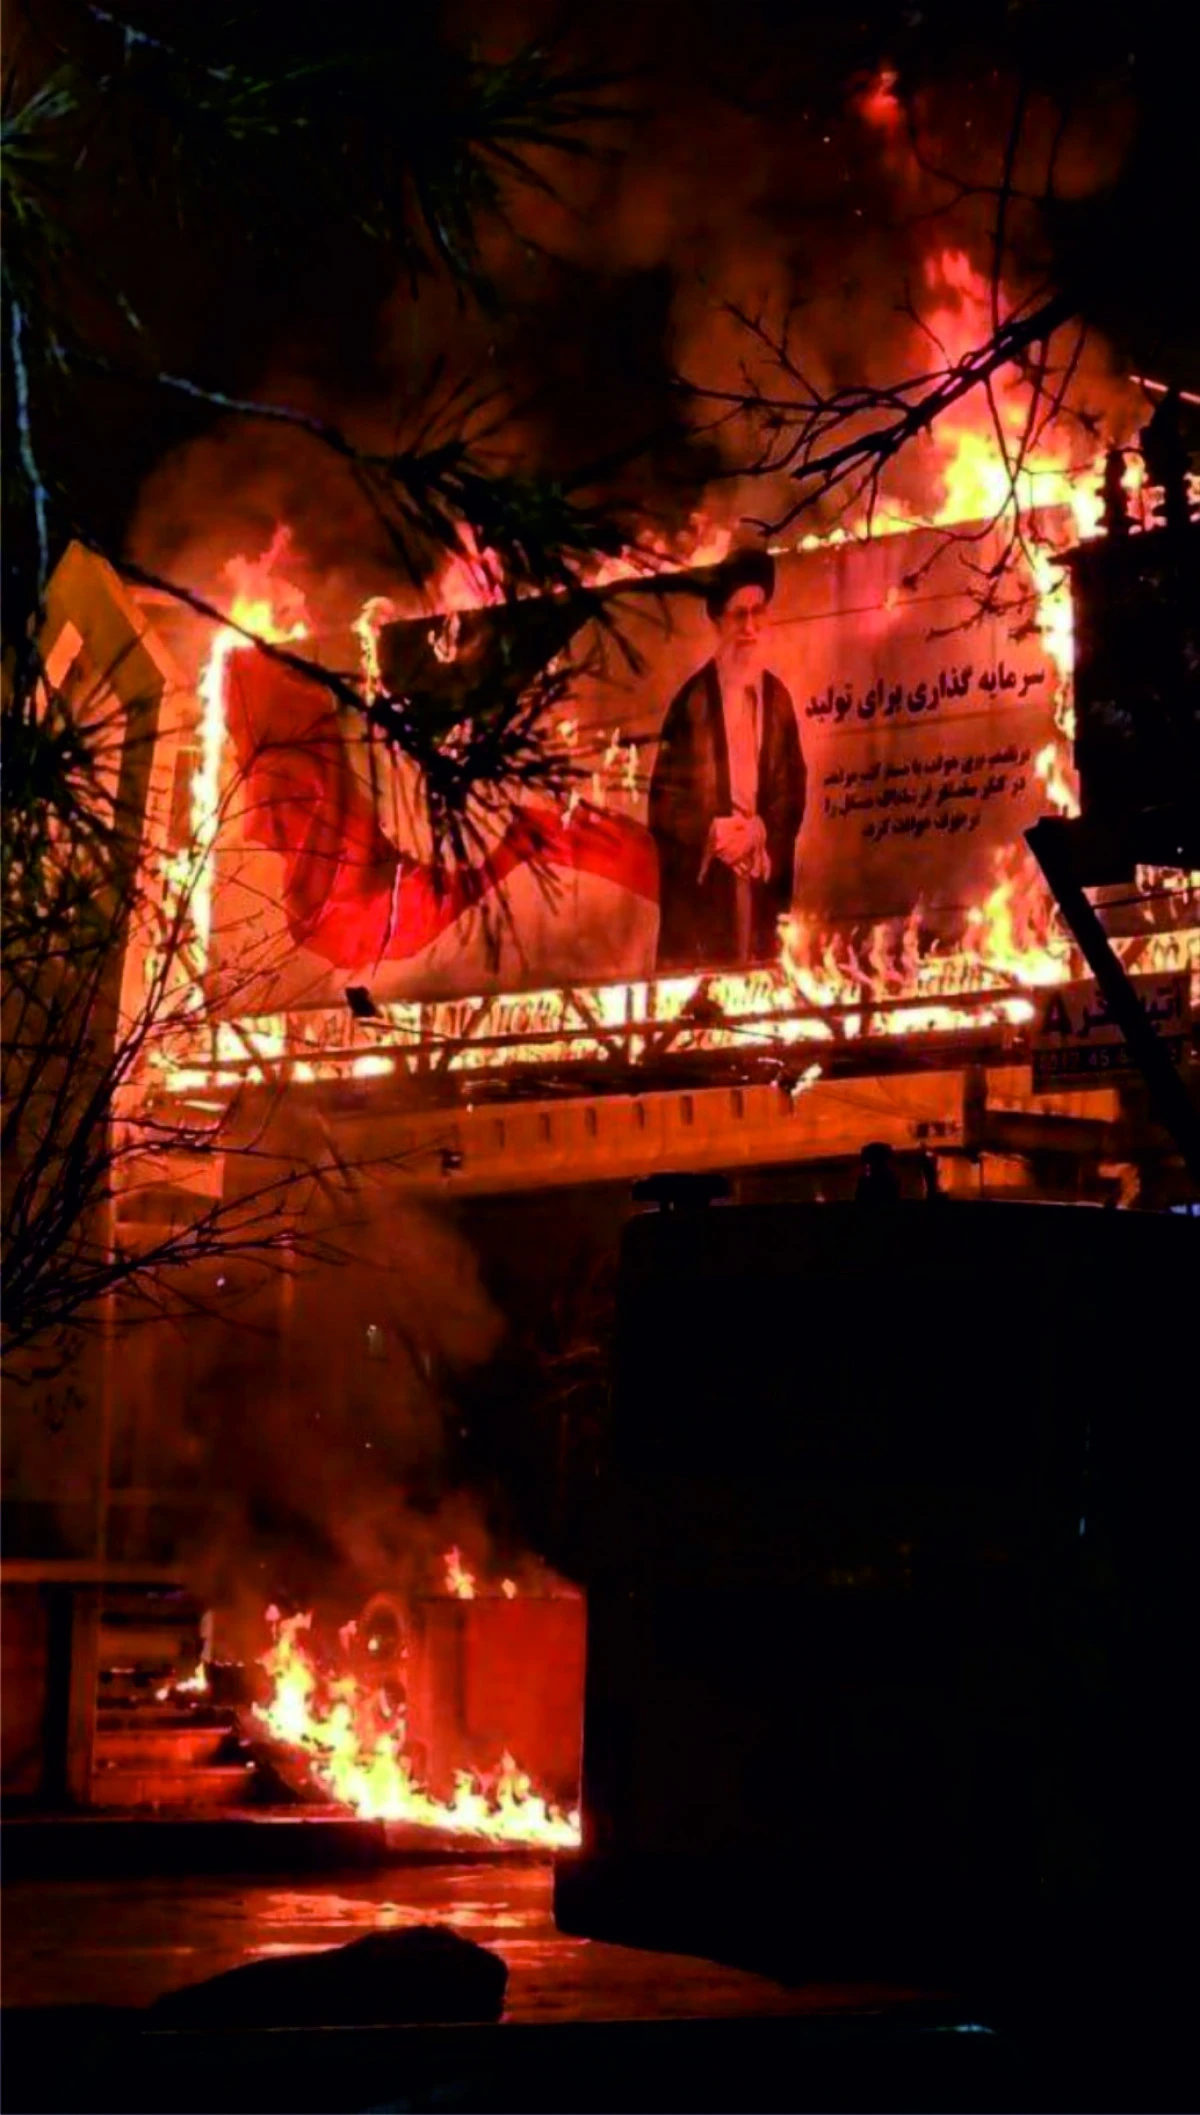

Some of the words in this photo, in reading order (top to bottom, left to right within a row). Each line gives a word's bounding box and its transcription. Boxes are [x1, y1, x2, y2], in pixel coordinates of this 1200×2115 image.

[857, 678, 903, 720] برای
[907, 664, 972, 712] گذاری
[979, 661, 1045, 699] سرمایه
[805, 683, 853, 723] تولید
